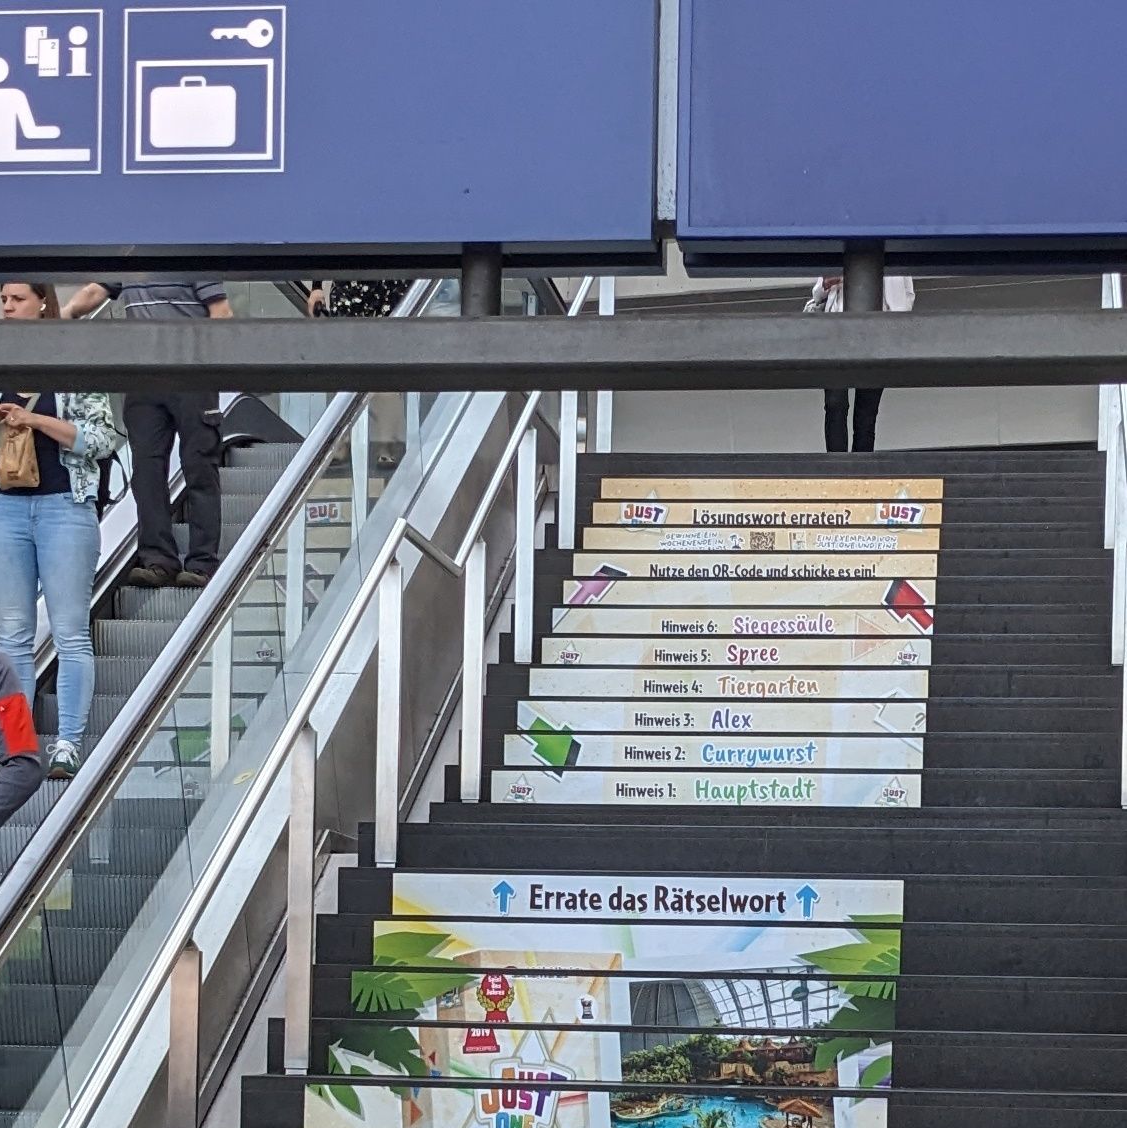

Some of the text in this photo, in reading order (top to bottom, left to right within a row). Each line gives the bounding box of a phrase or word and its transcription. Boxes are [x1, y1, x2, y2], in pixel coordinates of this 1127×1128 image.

[624, 503, 664, 523] JUST
[693, 508, 852, 525] Lösungswort erraten?
[879, 503, 921, 523] JUST
[649, 563, 684, 577] Nutze
[687, 564, 709, 577] den
[766, 564, 790, 577] und
[791, 565, 835, 577] schicke
[838, 566, 851, 577] es
[854, 564, 876, 577] ein!
[661, 613, 835, 634] Hinweis 6: Siegessäule
[654, 644, 780, 666] Hinweis 5: Spree
[643, 675, 819, 698] Hinweis 4: Tiergarten
[634, 708, 753, 730] Hinweis 3: Alex
[624, 741, 817, 767] Hinweis 2: Currywurst
[615, 777, 816, 805] Hinweis 1: Hauptstadt
[529, 884, 787, 914] Errate das Rätselwort
[481, 1086, 552, 1117] JUST
